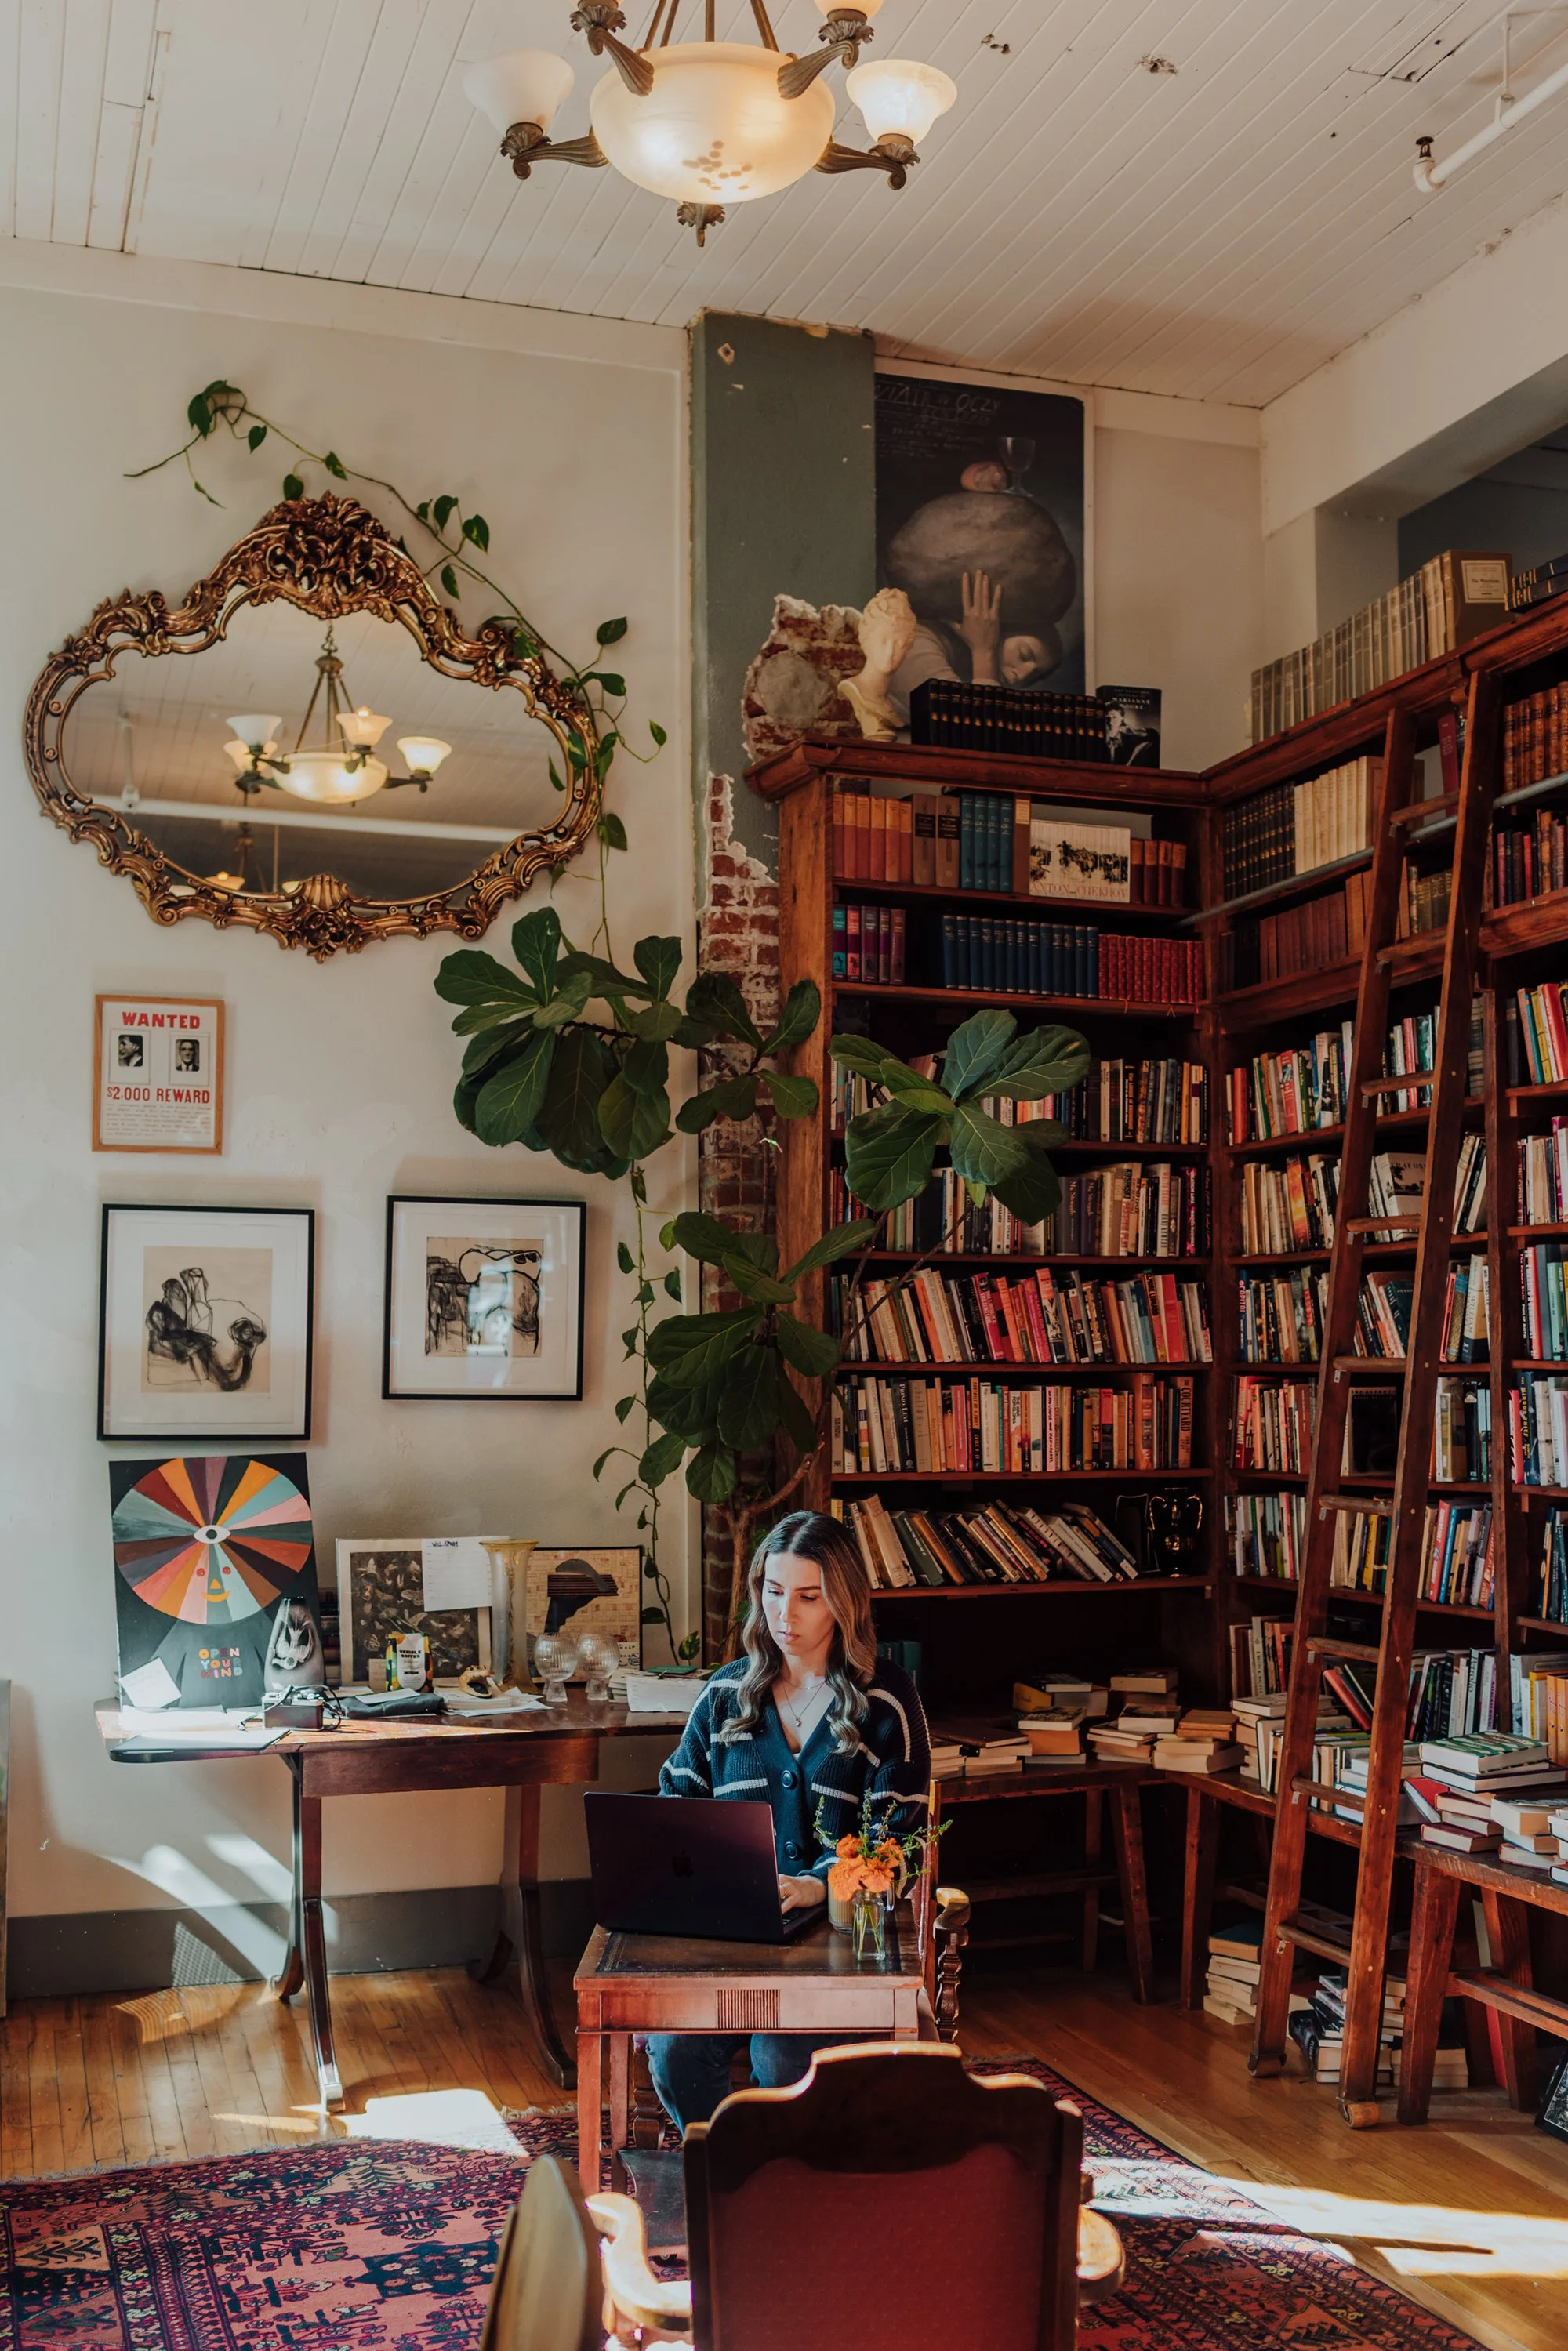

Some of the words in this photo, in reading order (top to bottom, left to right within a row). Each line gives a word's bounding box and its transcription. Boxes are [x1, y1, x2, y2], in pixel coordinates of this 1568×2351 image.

[1030, 883, 1070, 894] ANTON
[1075, 885, 1127, 898] CHEKHOV
[122, 1011, 201, 1029] WANTED
[156, 1087, 210, 1105] REWARD
[898, 1384, 907, 1406] PRIMO
[1181, 1388, 1192, 1431] COURTYARD
[198, 1647, 240, 1660] OPEN
[201, 1657, 241, 1670] YOUR
[201, 1667, 243, 1678] MIND
[1468, 1655, 1479, 1693] Petrolio
